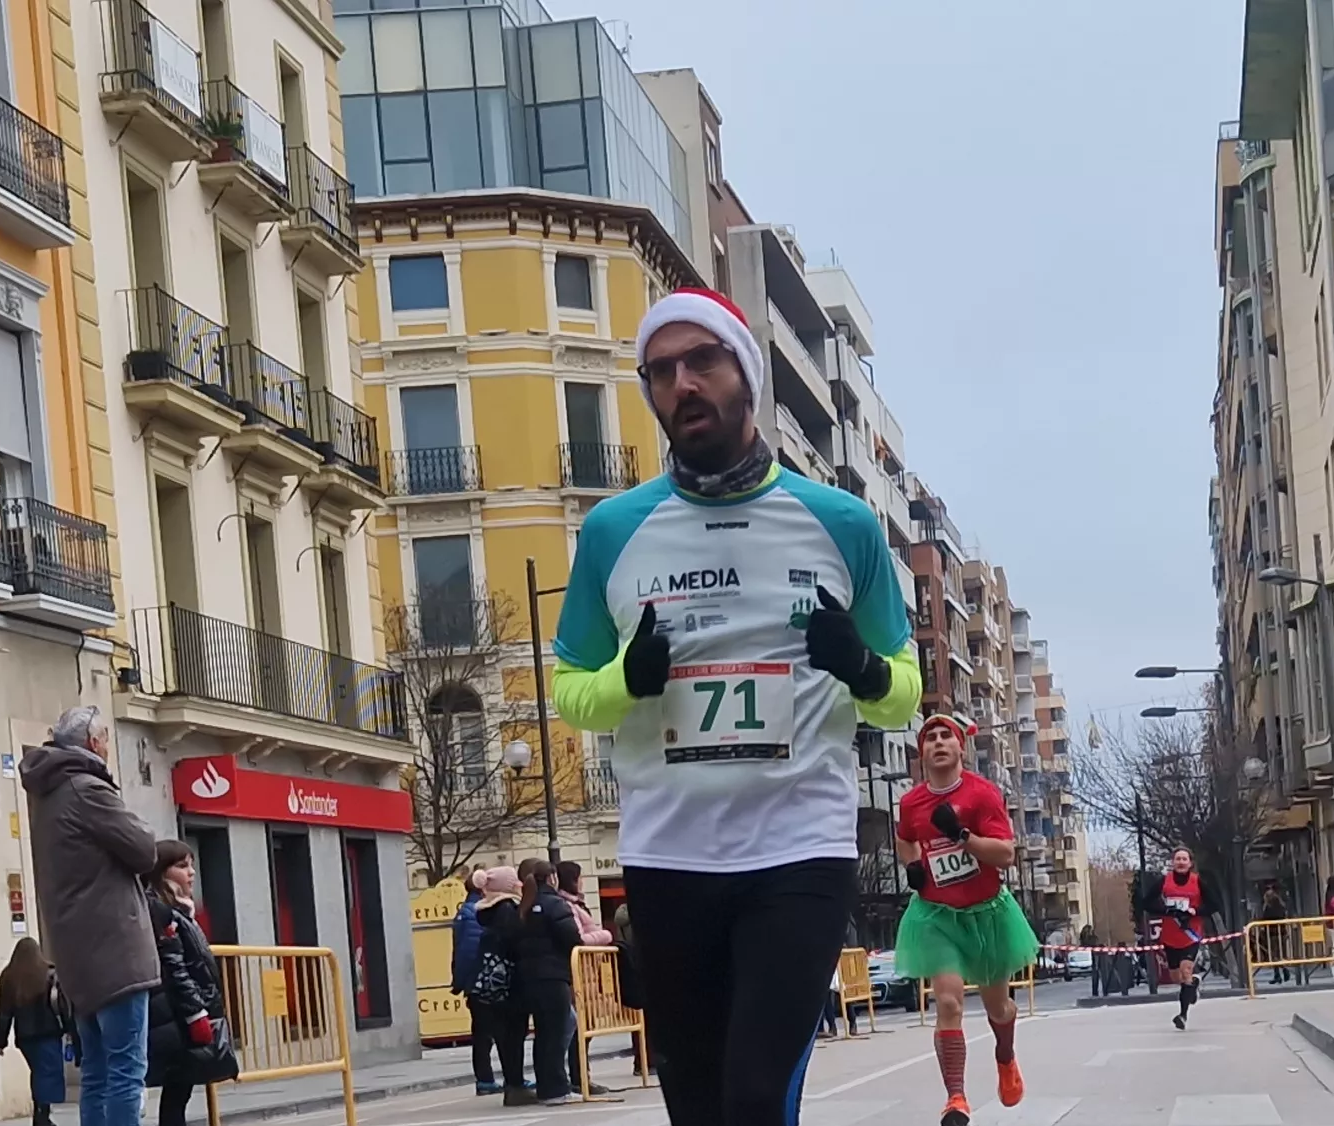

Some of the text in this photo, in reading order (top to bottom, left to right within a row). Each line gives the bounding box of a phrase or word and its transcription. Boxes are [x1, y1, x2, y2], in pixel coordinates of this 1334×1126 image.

[637, 568, 741, 597] LA MEDIA
[693, 679, 765, 732] 71
[298, 788, 338, 817] Santander
[936, 851, 974, 875] 104
[414, 904, 450, 920] ería
[418, 999, 461, 1013] Crep
